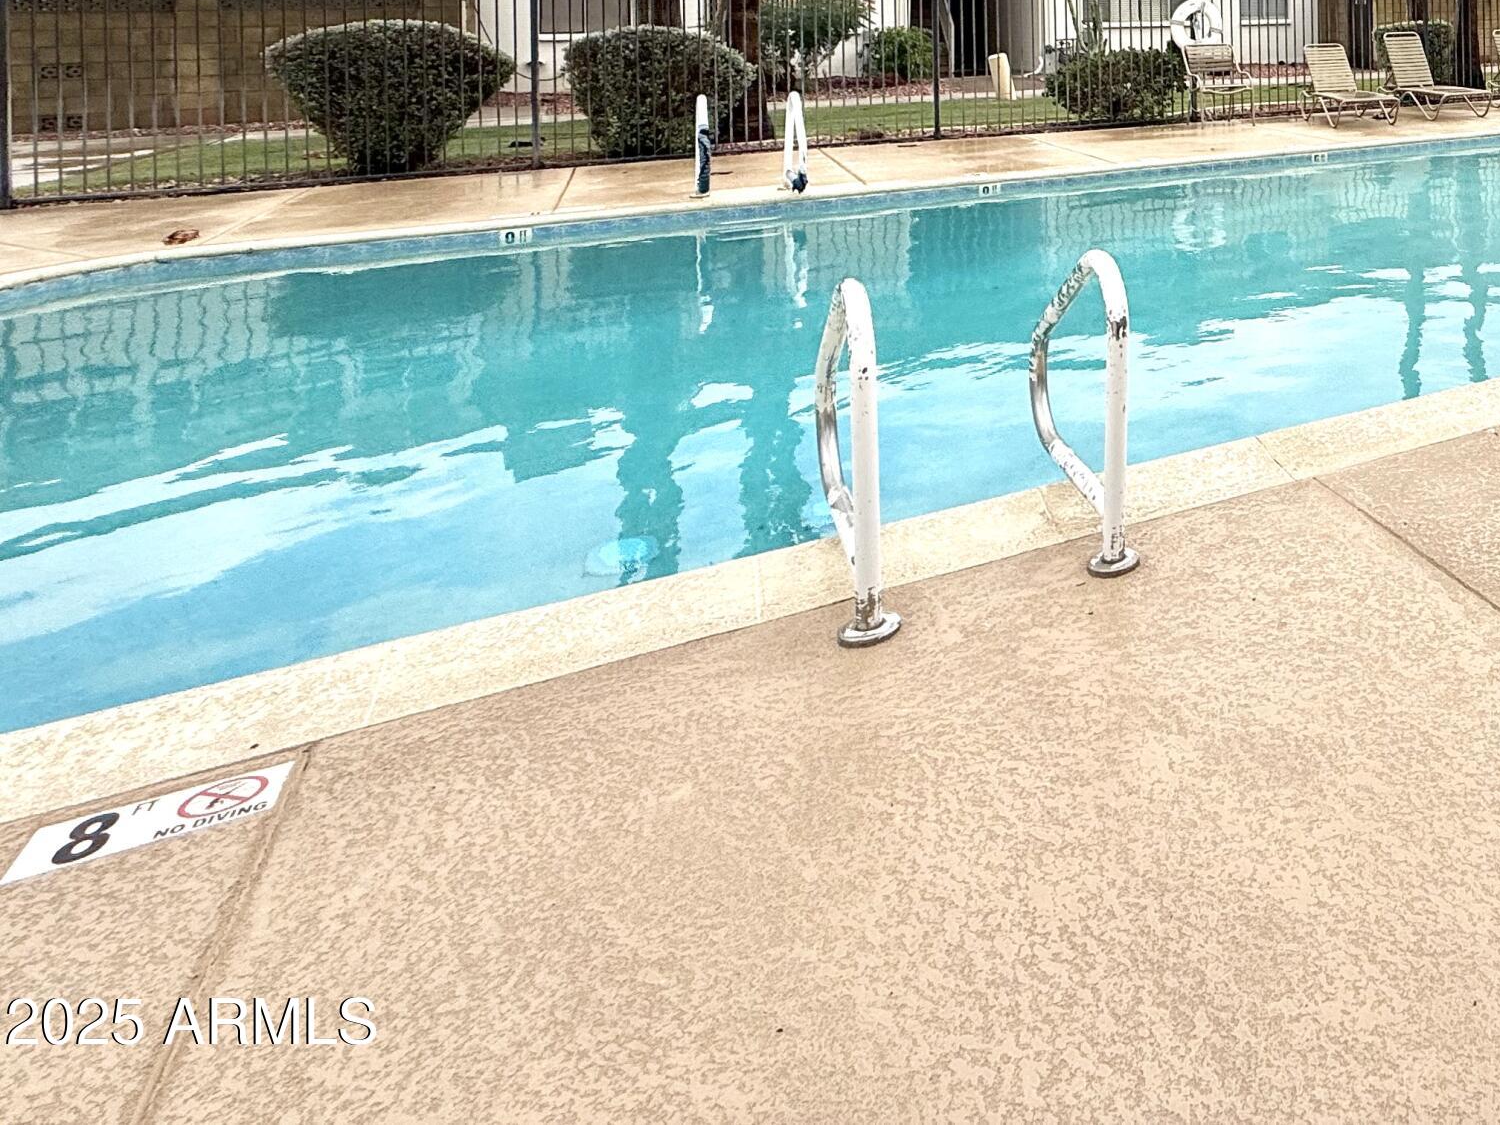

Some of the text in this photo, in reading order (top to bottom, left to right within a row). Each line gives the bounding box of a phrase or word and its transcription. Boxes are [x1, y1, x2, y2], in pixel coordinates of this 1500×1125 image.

[51, 798, 161, 864] 8 FT
[153, 801, 268, 839] NO DIVING
